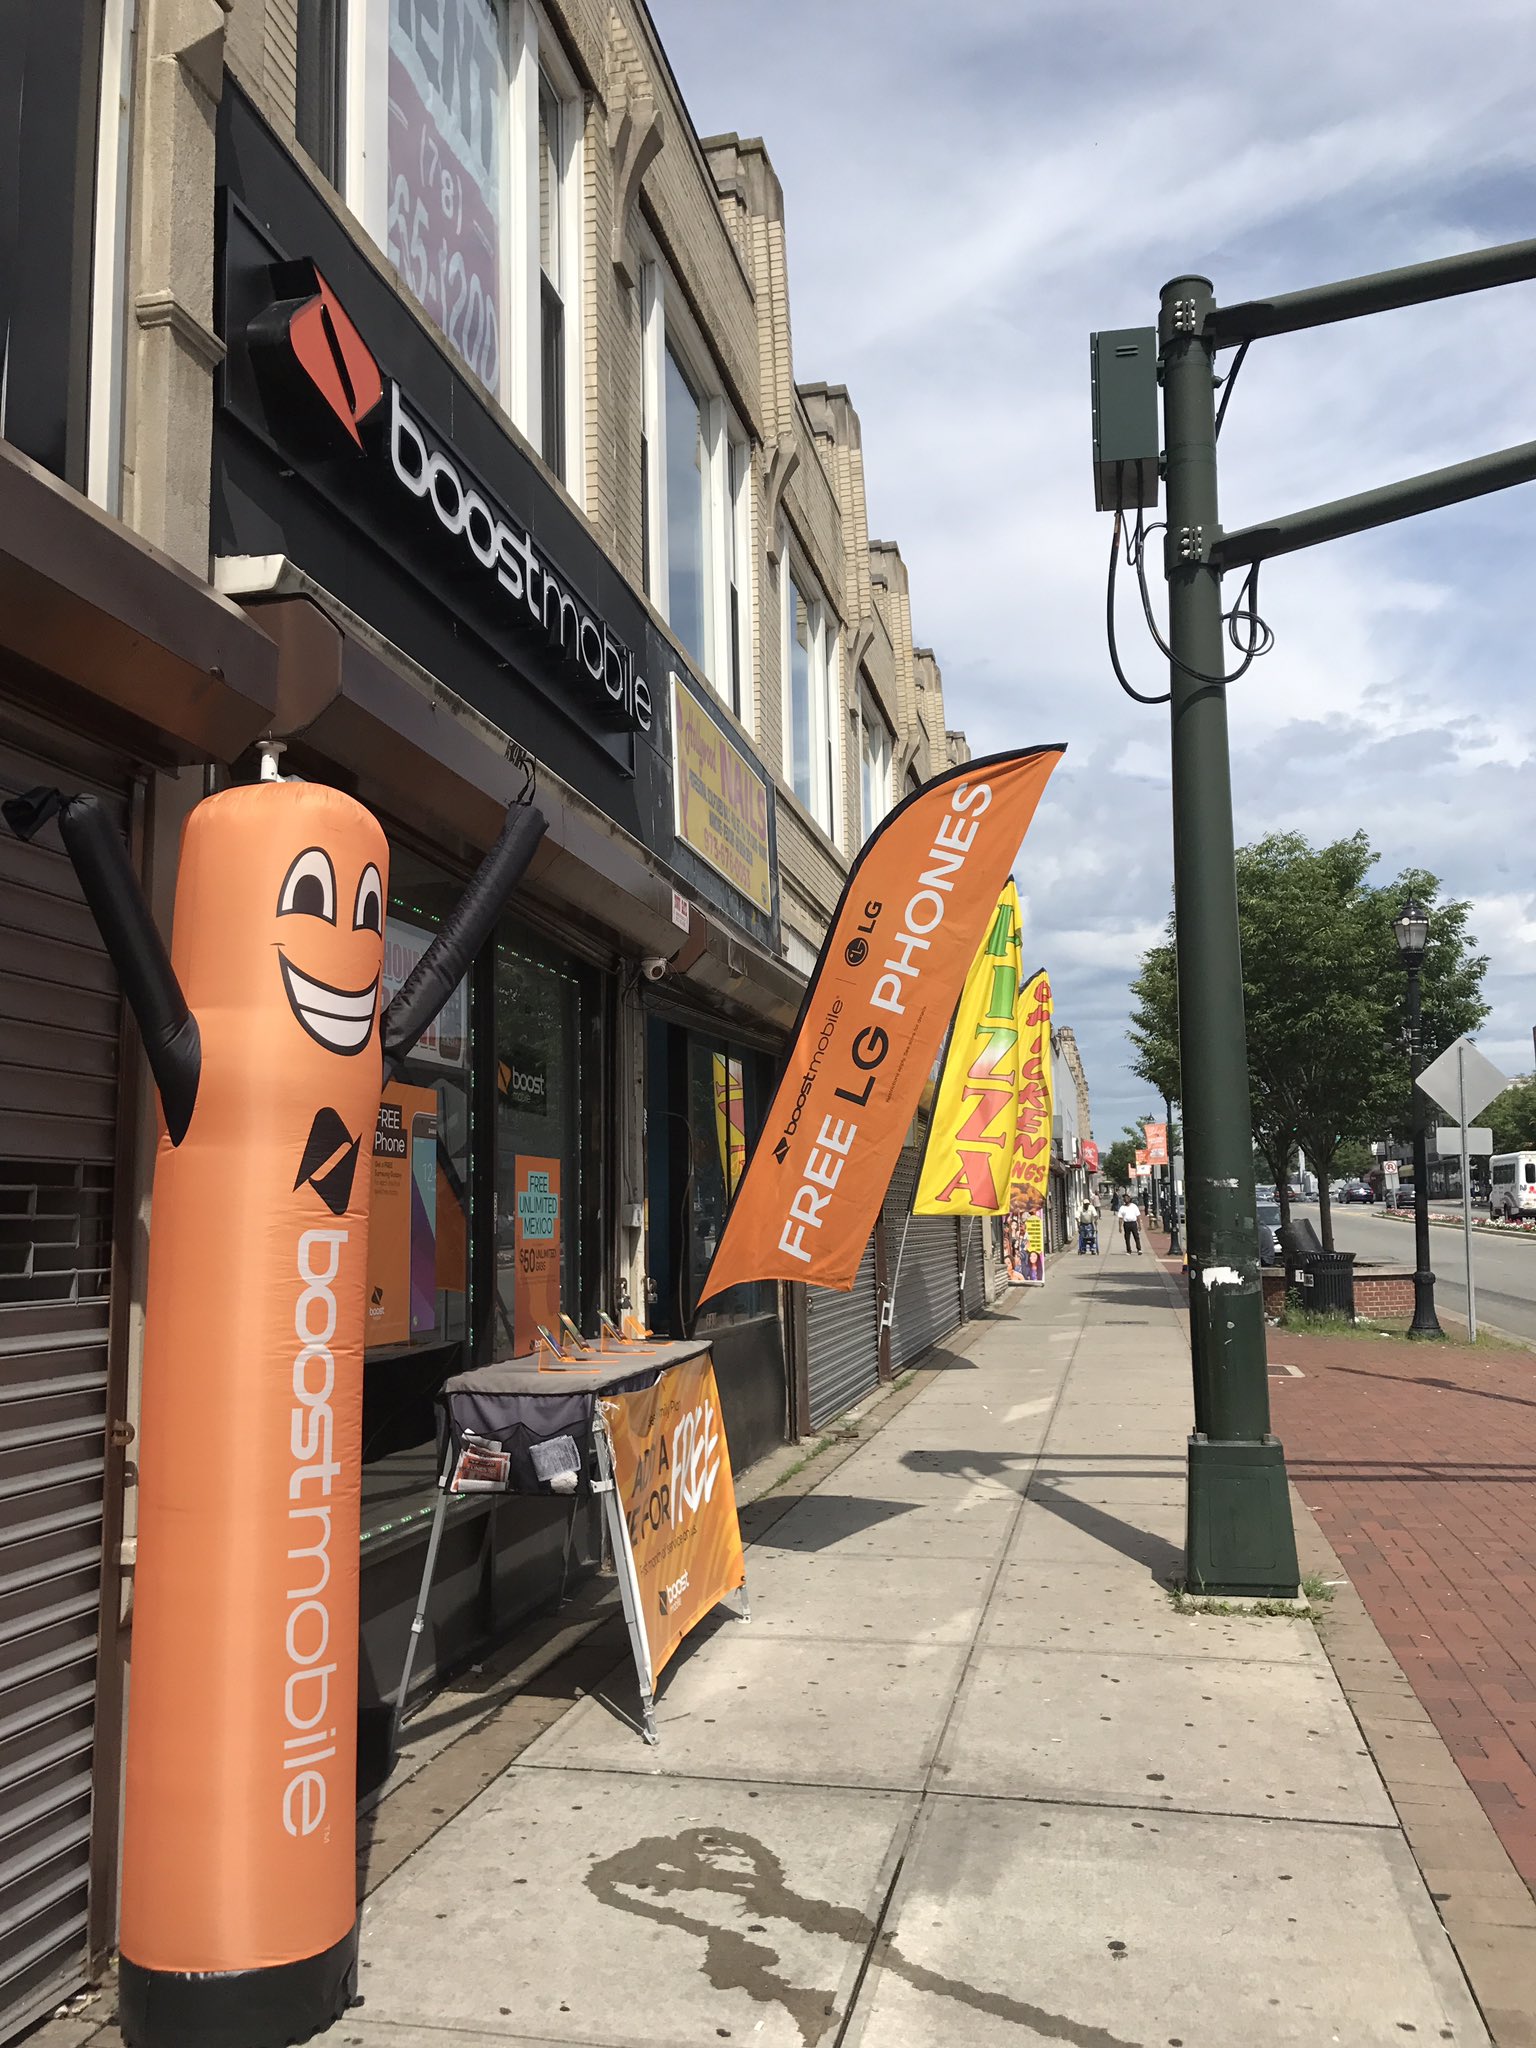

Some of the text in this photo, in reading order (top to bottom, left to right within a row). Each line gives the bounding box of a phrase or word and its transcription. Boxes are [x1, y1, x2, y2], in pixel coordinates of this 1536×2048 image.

[391, 378, 652, 731] boostmobile
[720, 740, 767, 842] NAILS
[777, 781, 993, 1265] FREE LG PHONES
[783, 900, 882, 1137] boostmobile LG
[512, 1065, 545, 1096] boost
[374, 1131, 406, 1153] Phone
[529, 1175, 548, 1193] FREE
[519, 1196, 558, 1214] UNLIMITED
[524, 1217, 553, 1234] MEXICO
[519, 1248, 536, 1273] $50
[658, 1434, 669, 1476] A
[671, 1398, 721, 1531] FREE
[283, 1229, 348, 1838] boostmobile
[666, 1568, 690, 1604] boost
